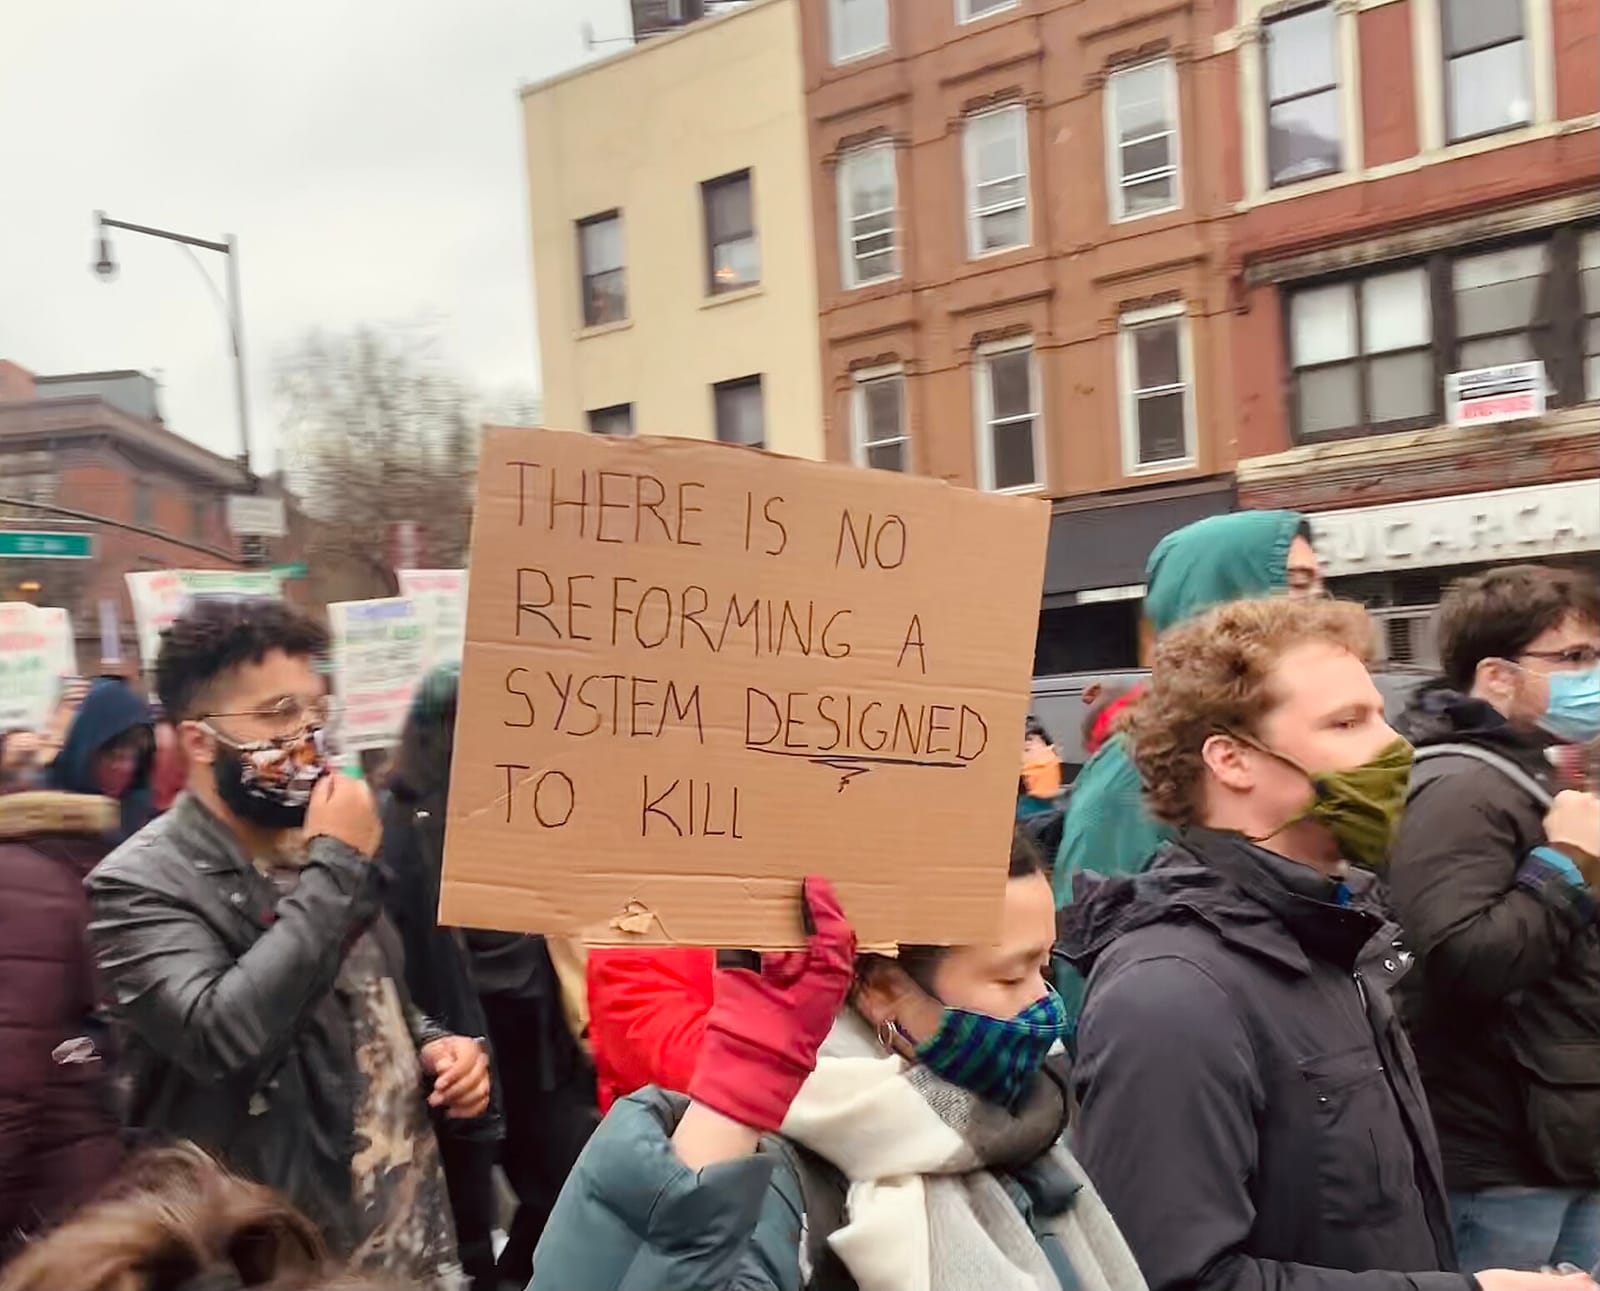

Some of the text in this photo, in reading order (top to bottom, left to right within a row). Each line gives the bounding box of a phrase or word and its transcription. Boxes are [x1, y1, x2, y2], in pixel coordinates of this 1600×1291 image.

[507, 462, 906, 569] THERE IS NO
[516, 568, 852, 658] REFORMING
[897, 614, 925, 674] A
[504, 668, 987, 760] SYSTEM DESIGNED
[495, 765, 742, 838] TO KILL
